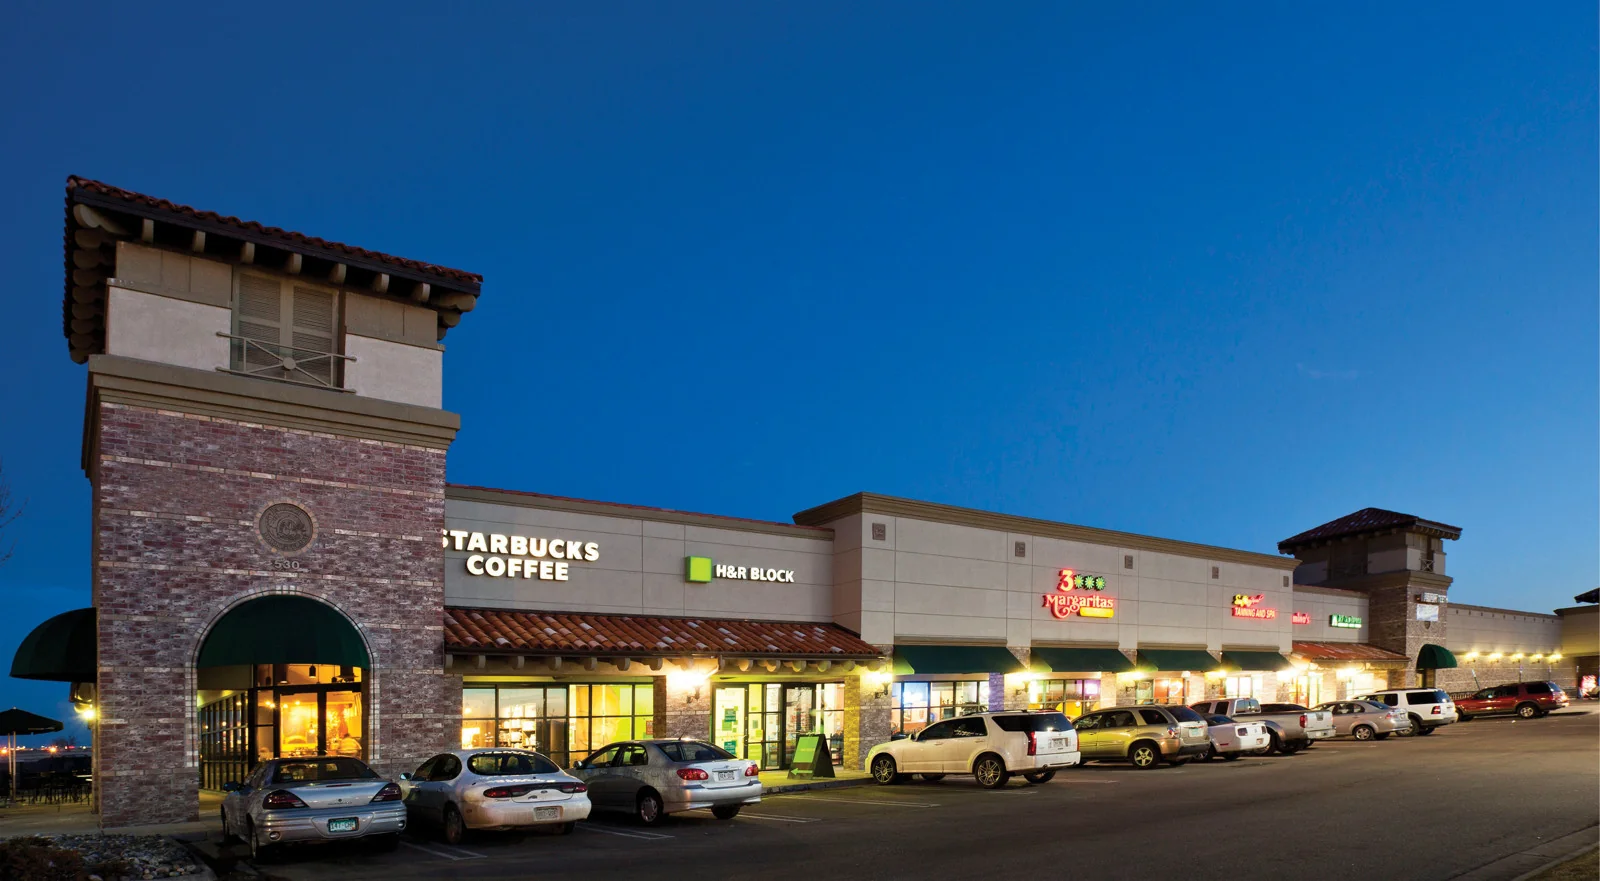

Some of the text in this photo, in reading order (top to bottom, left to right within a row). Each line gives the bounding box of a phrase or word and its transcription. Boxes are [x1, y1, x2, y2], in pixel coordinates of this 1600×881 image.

[274, 559, 300, 570] 530
[465, 554, 570, 582] COFFEE
[715, 563, 795, 583] H&R BLOCK
[1059, 568, 1074, 592] 3
[1044, 594, 1114, 619] Margaritas
[1266, 609, 1276, 619] SPA
